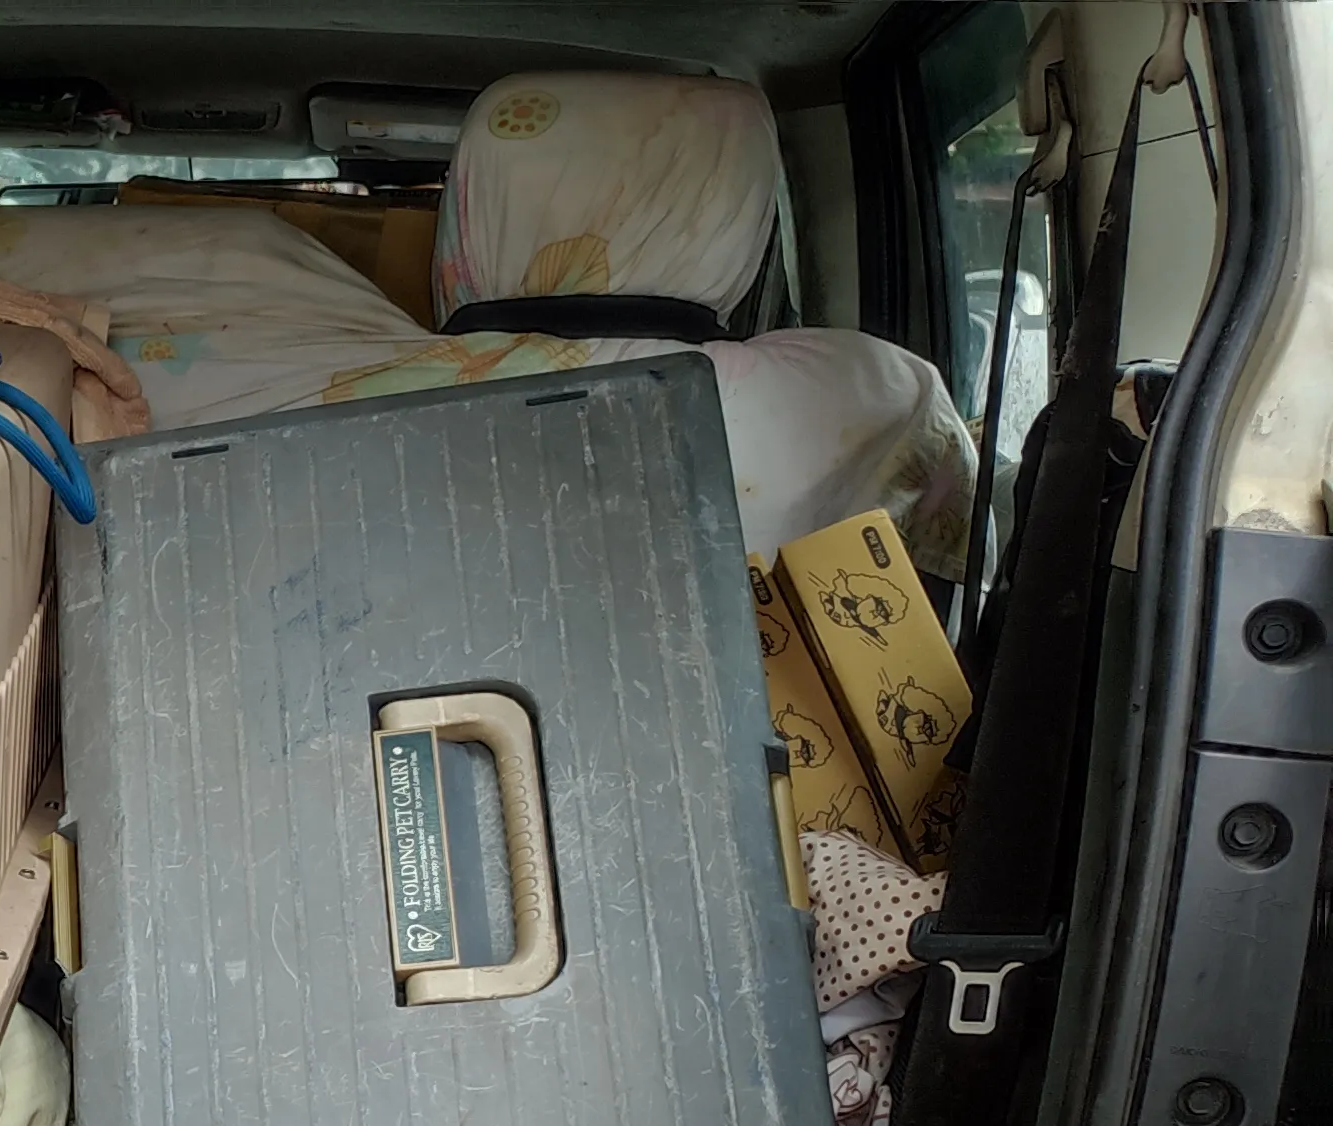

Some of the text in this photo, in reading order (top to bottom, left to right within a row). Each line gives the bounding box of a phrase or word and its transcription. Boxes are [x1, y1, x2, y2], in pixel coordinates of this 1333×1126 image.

[391, 758, 420, 908] FOLDING PET CARRY
